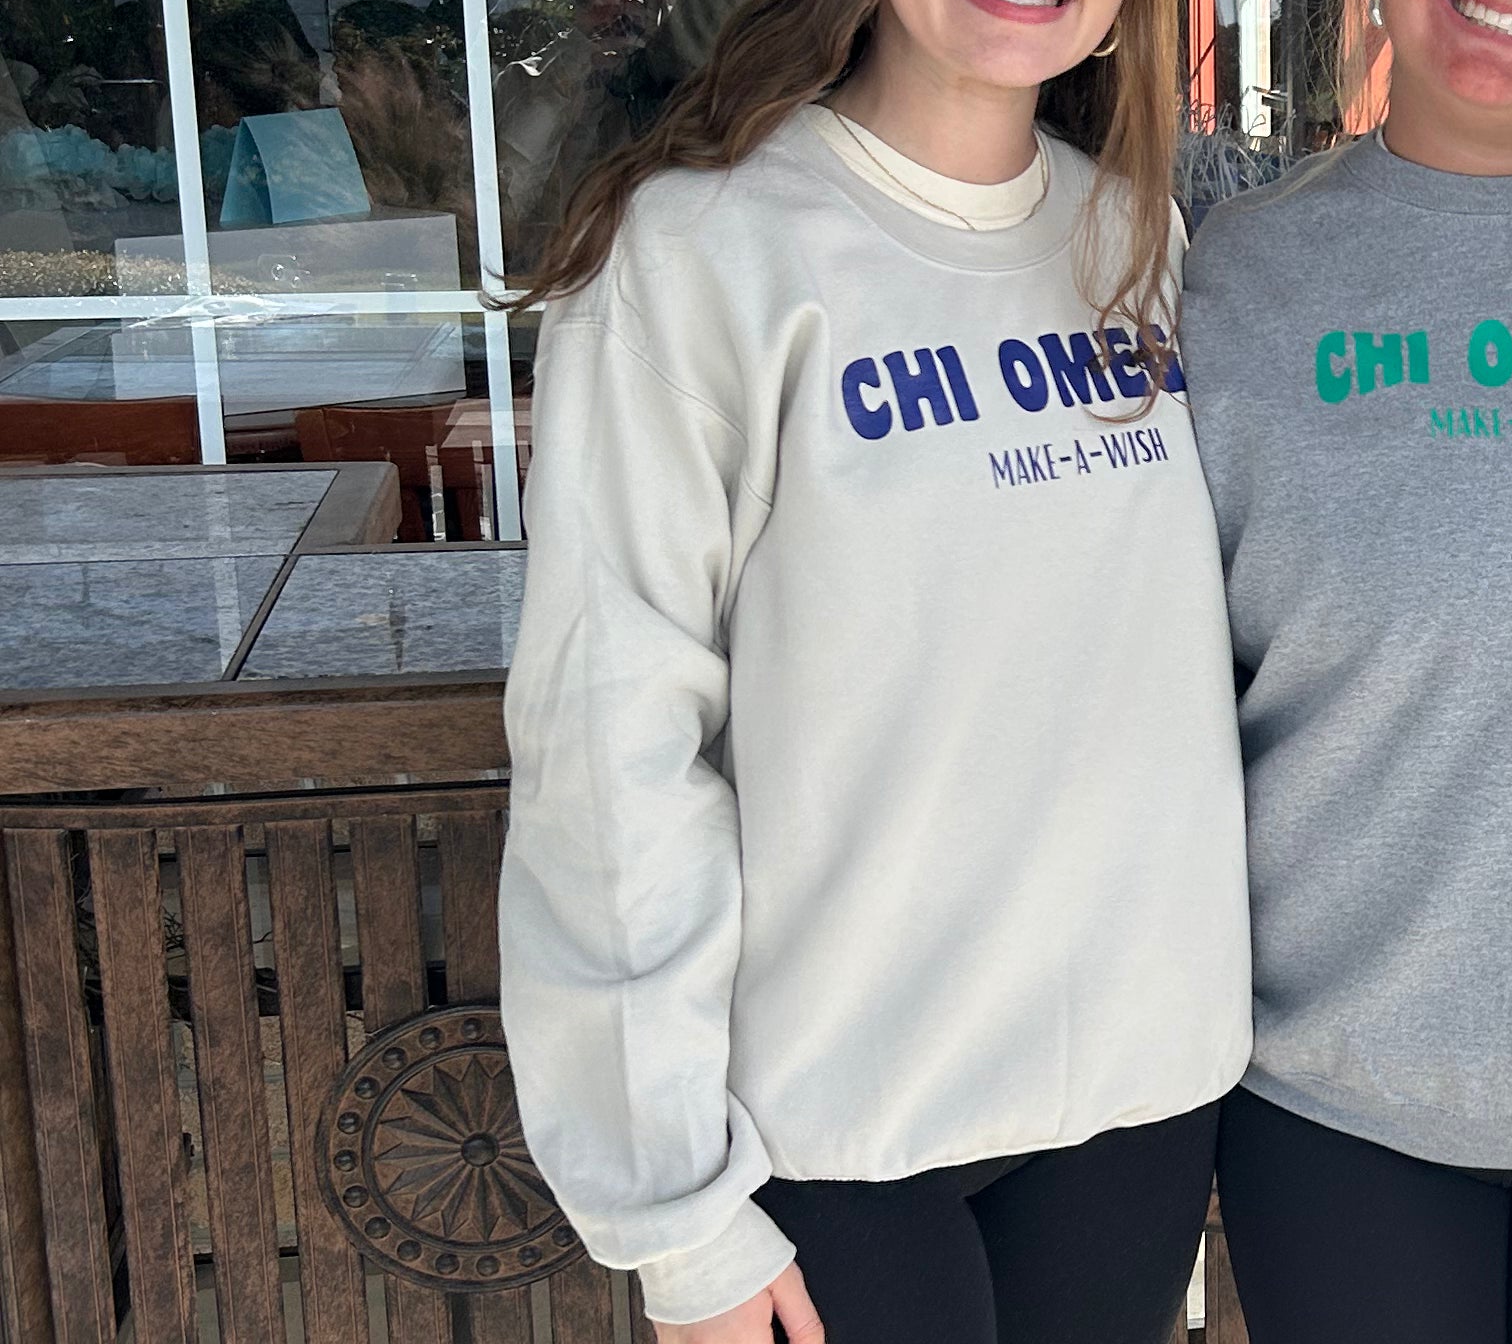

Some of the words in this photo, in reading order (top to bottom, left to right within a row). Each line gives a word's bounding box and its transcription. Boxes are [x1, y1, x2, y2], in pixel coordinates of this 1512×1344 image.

[841, 345, 980, 441] CHI
[1315, 329, 1430, 404] CHI
[989, 428, 1169, 489] MAKE-A-WISH
